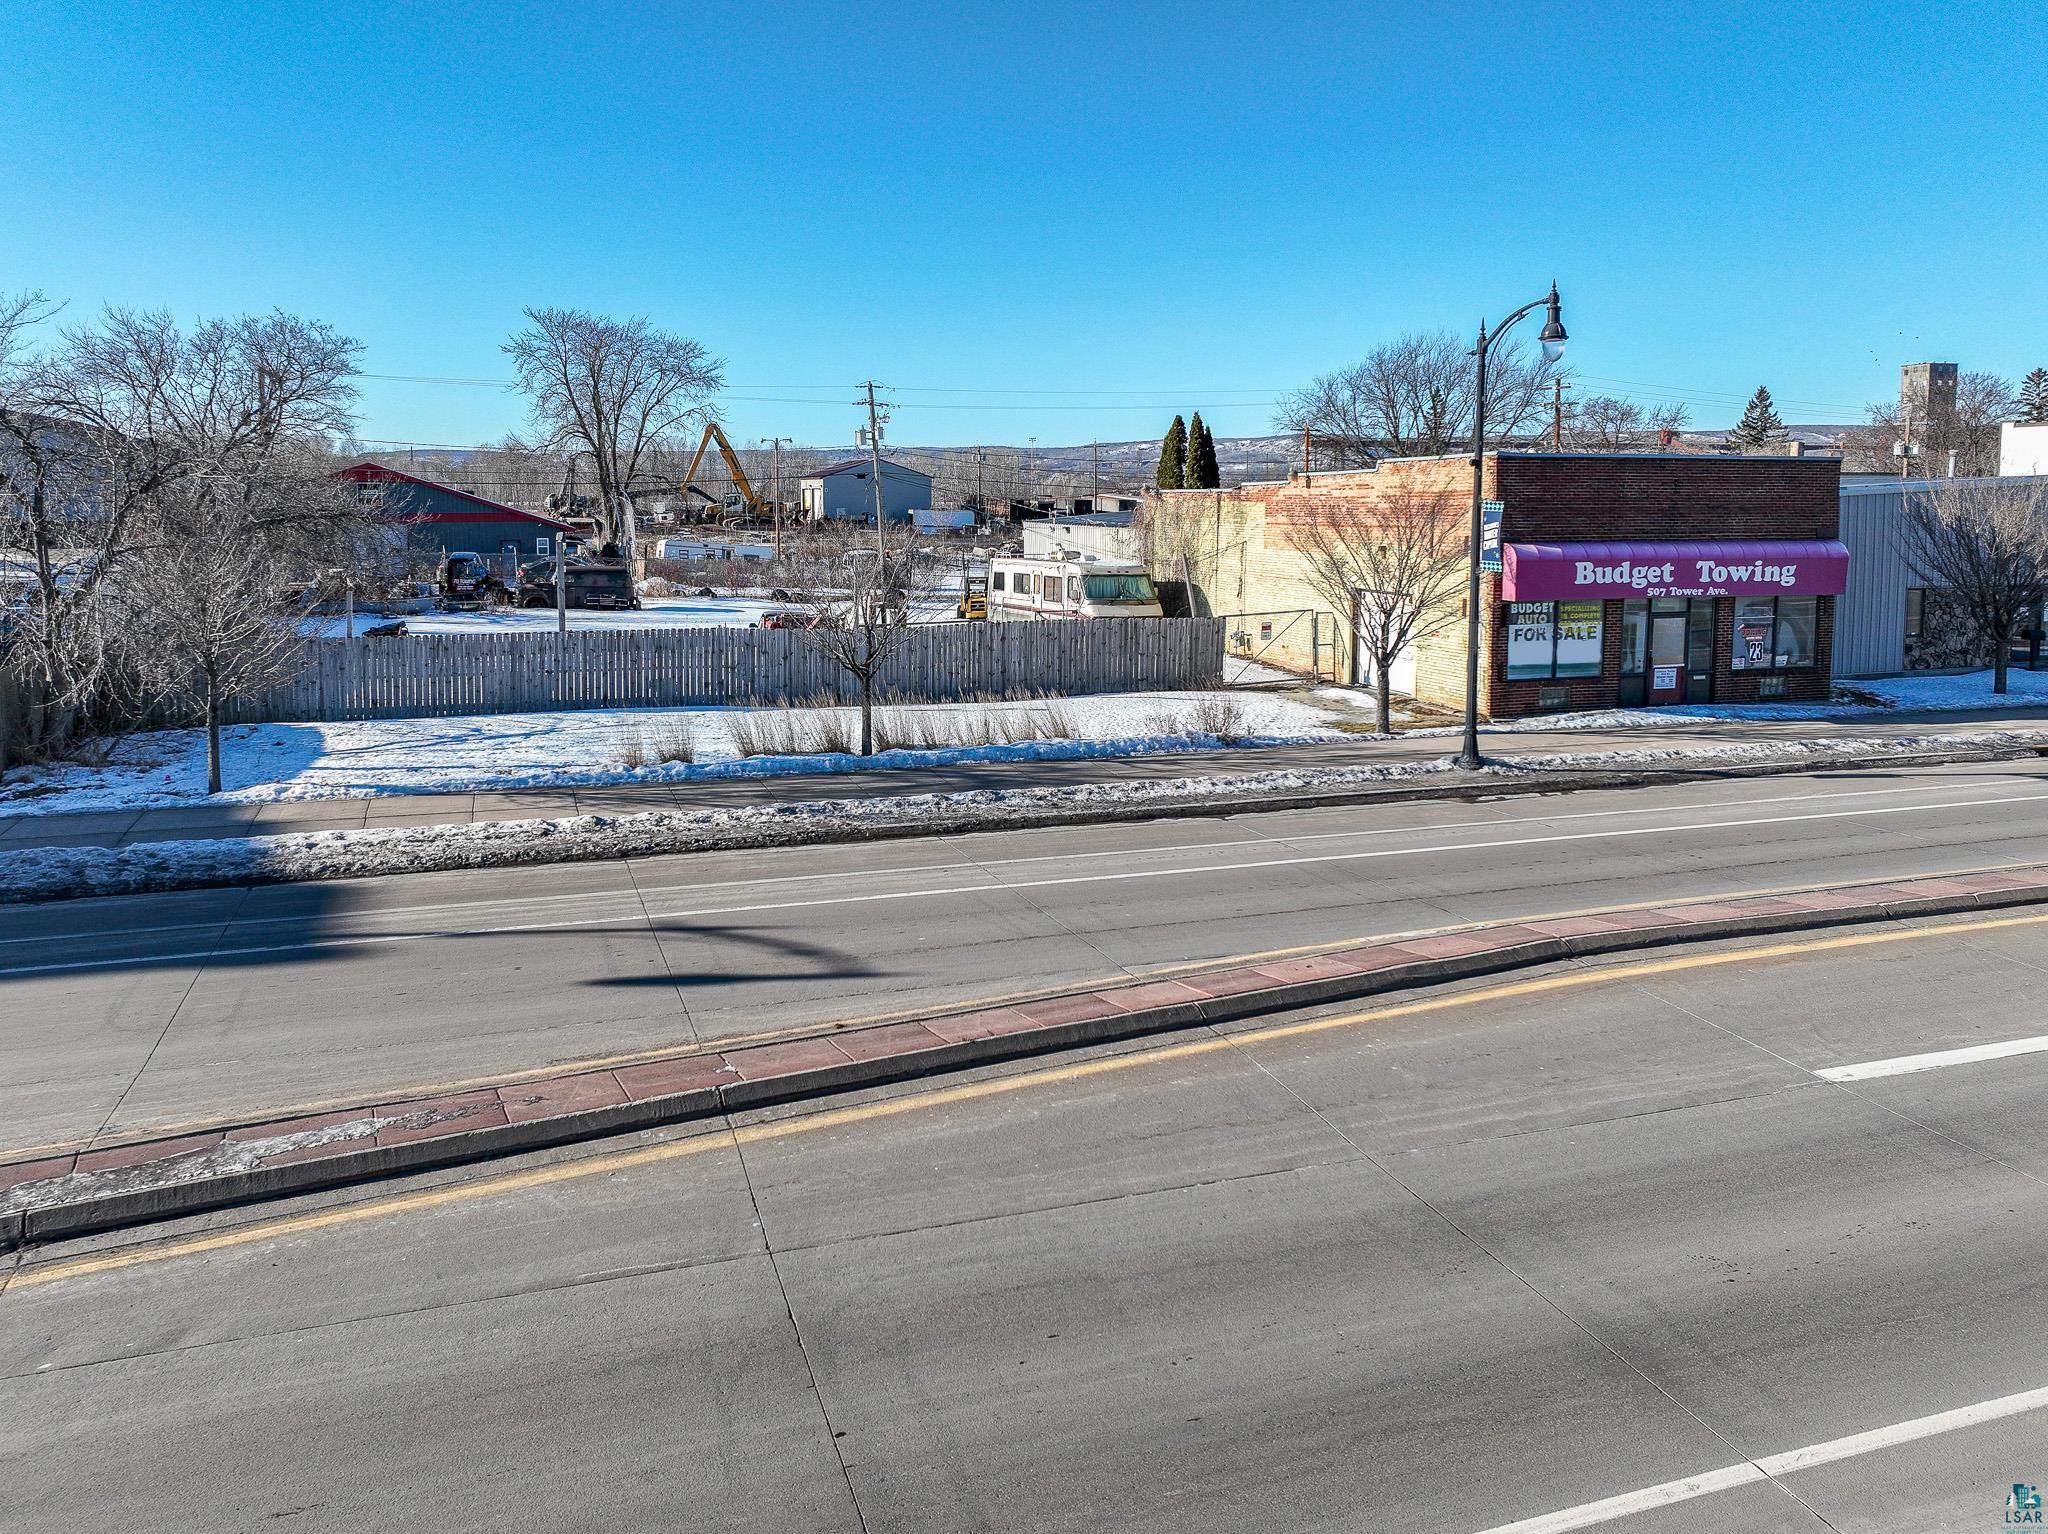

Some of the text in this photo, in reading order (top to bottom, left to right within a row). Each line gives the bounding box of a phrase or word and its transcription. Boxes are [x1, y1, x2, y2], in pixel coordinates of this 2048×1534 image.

[1574, 560, 1797, 588] Budget Towing
[1647, 586, 1728, 597] 507 Tower Ave.
[1511, 602, 1555, 613] BUDGET
[1517, 613, 1548, 624] AUTO
[1514, 626, 1597, 642] FOR SALE
[1750, 642, 1763, 662] 23
